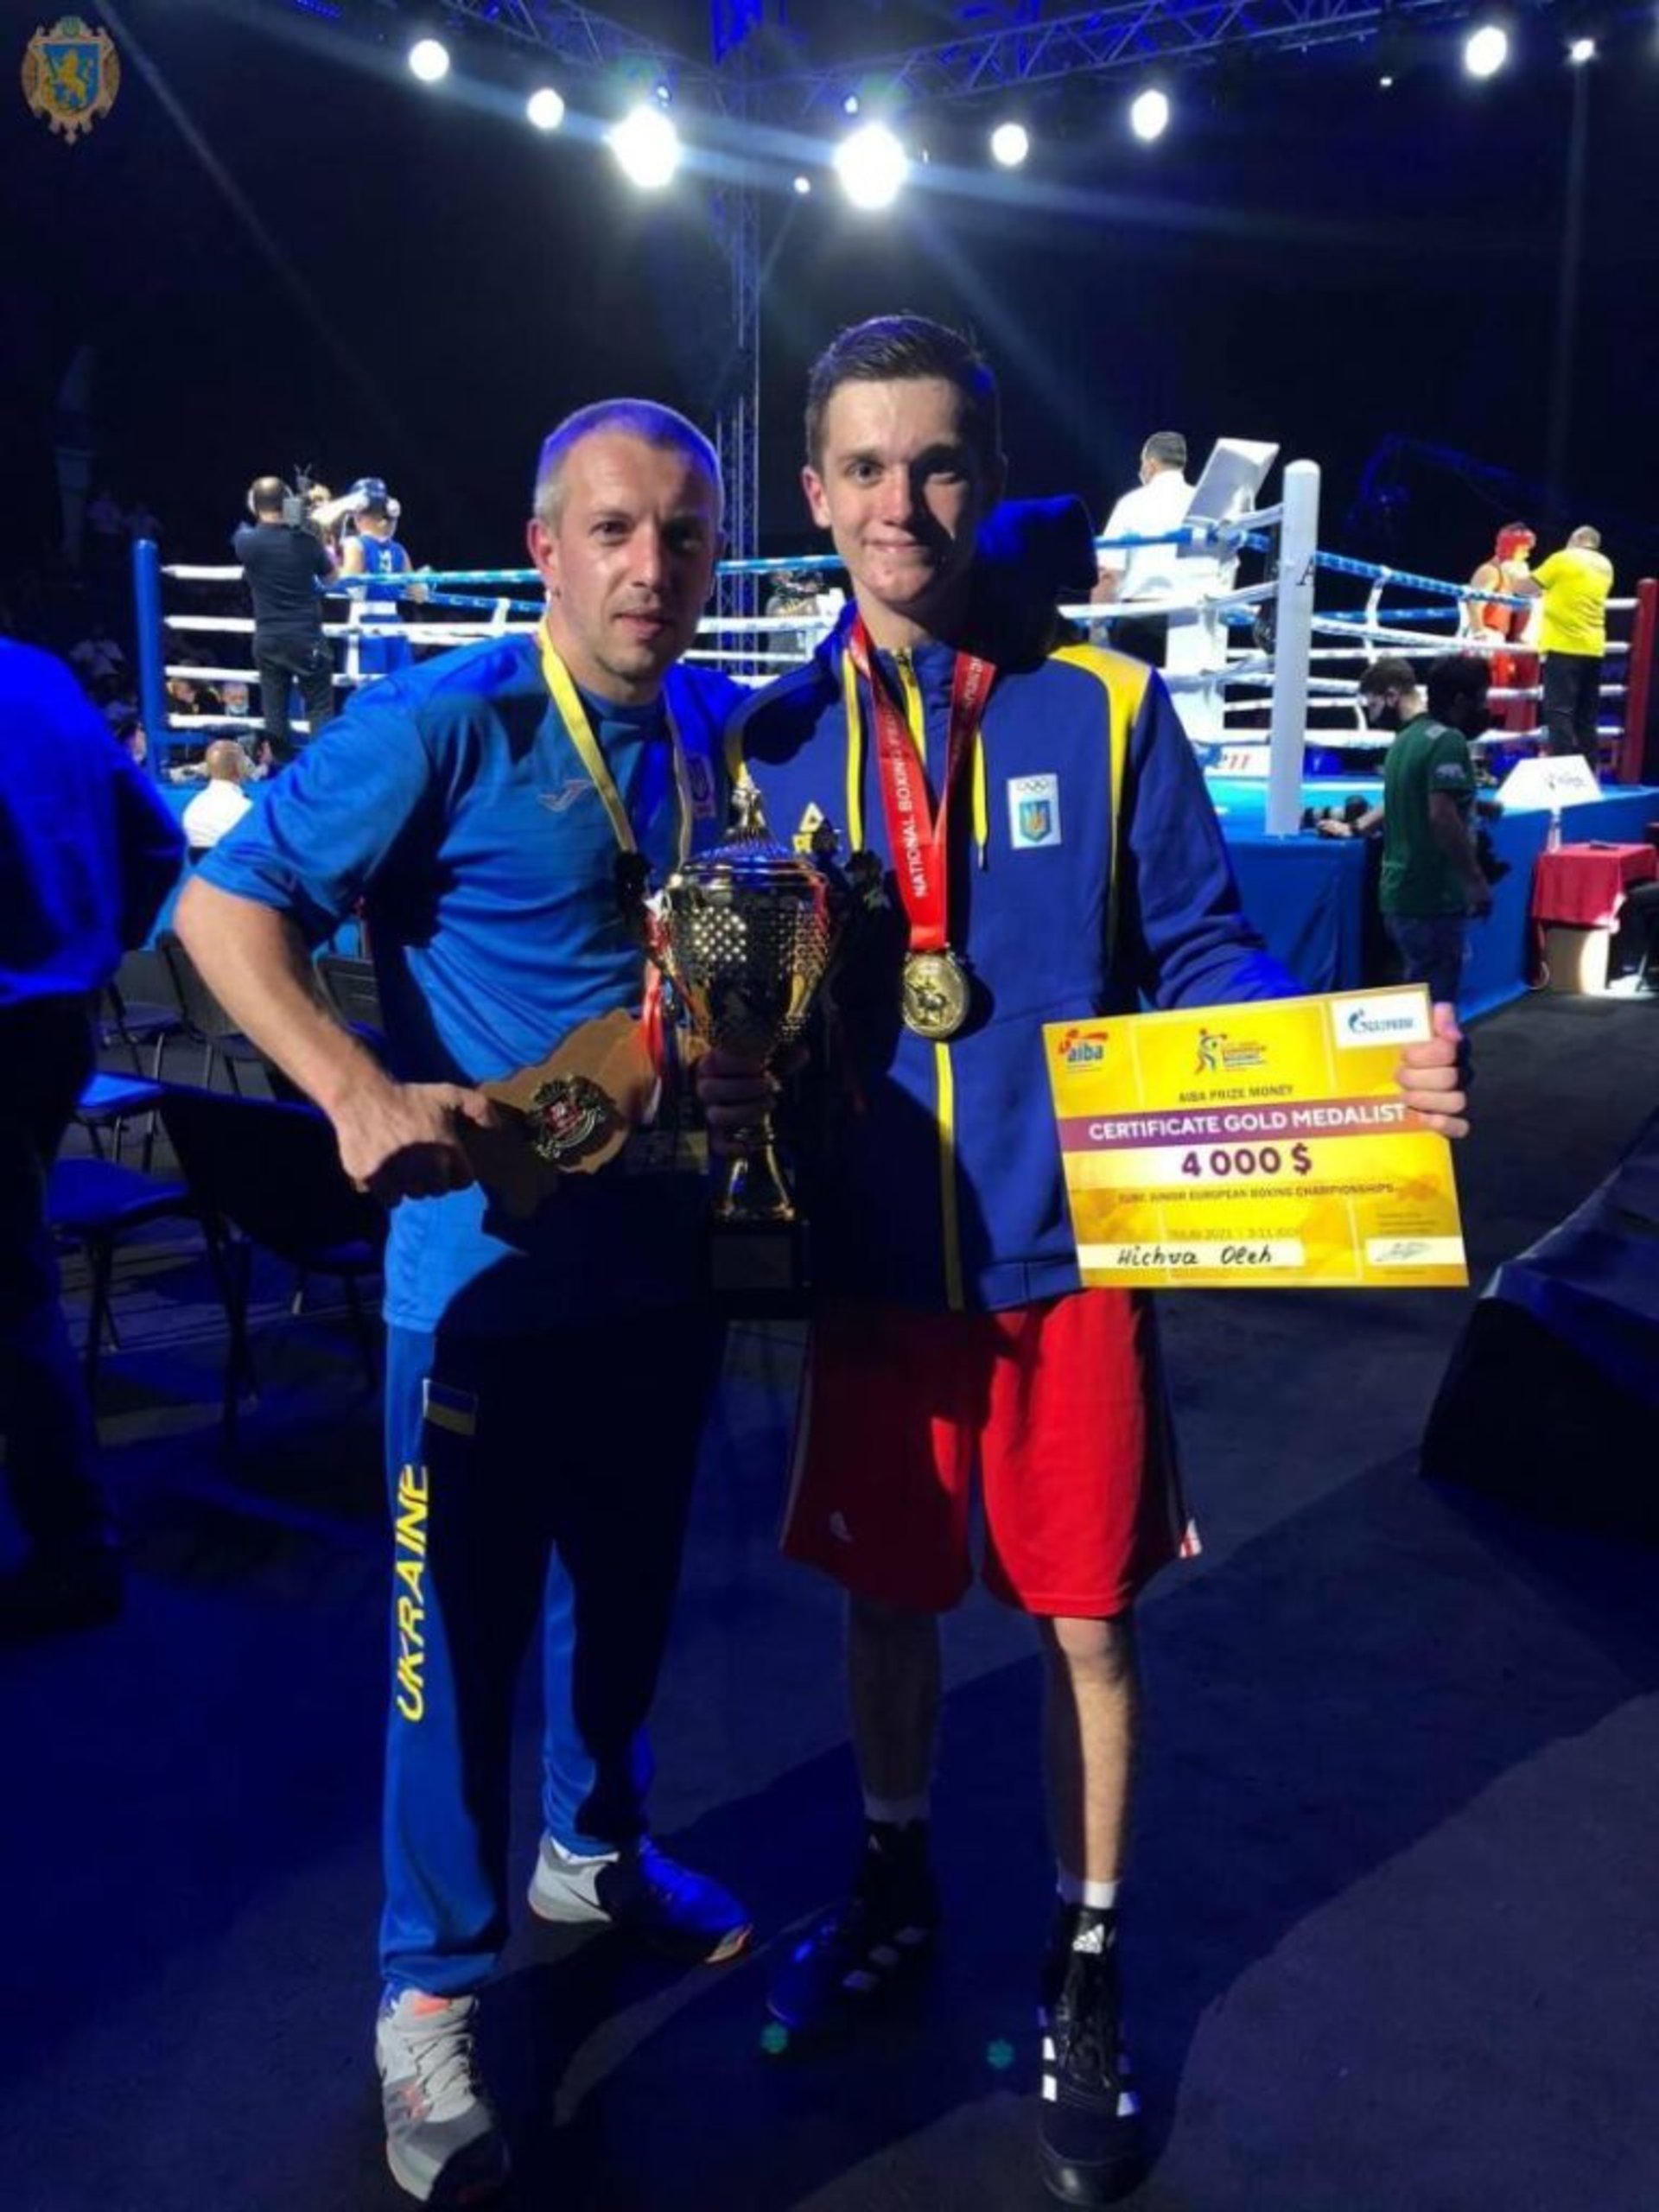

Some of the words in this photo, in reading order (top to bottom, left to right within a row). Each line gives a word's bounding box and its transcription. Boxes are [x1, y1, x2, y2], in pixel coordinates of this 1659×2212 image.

[902, 815, 928, 899] NATIONAL
[1210, 1088, 1245, 1100] PRIZE
[1249, 1084, 1294, 1097] MONEY
[1089, 1115, 1220, 1141] CERTIFICATE
[1224, 1110, 1288, 1133] GOLD
[1291, 1102, 1406, 1128] MEDALIST
[1291, 1141, 1313, 1175] $
[1189, 1188, 1247, 1200] EUROPEAN
[1250, 1186, 1293, 1198] BOXING
[1296, 1182, 1394, 1198] CHAMPIONSHIPS
[395, 1464, 429, 1721] UKRAINE
